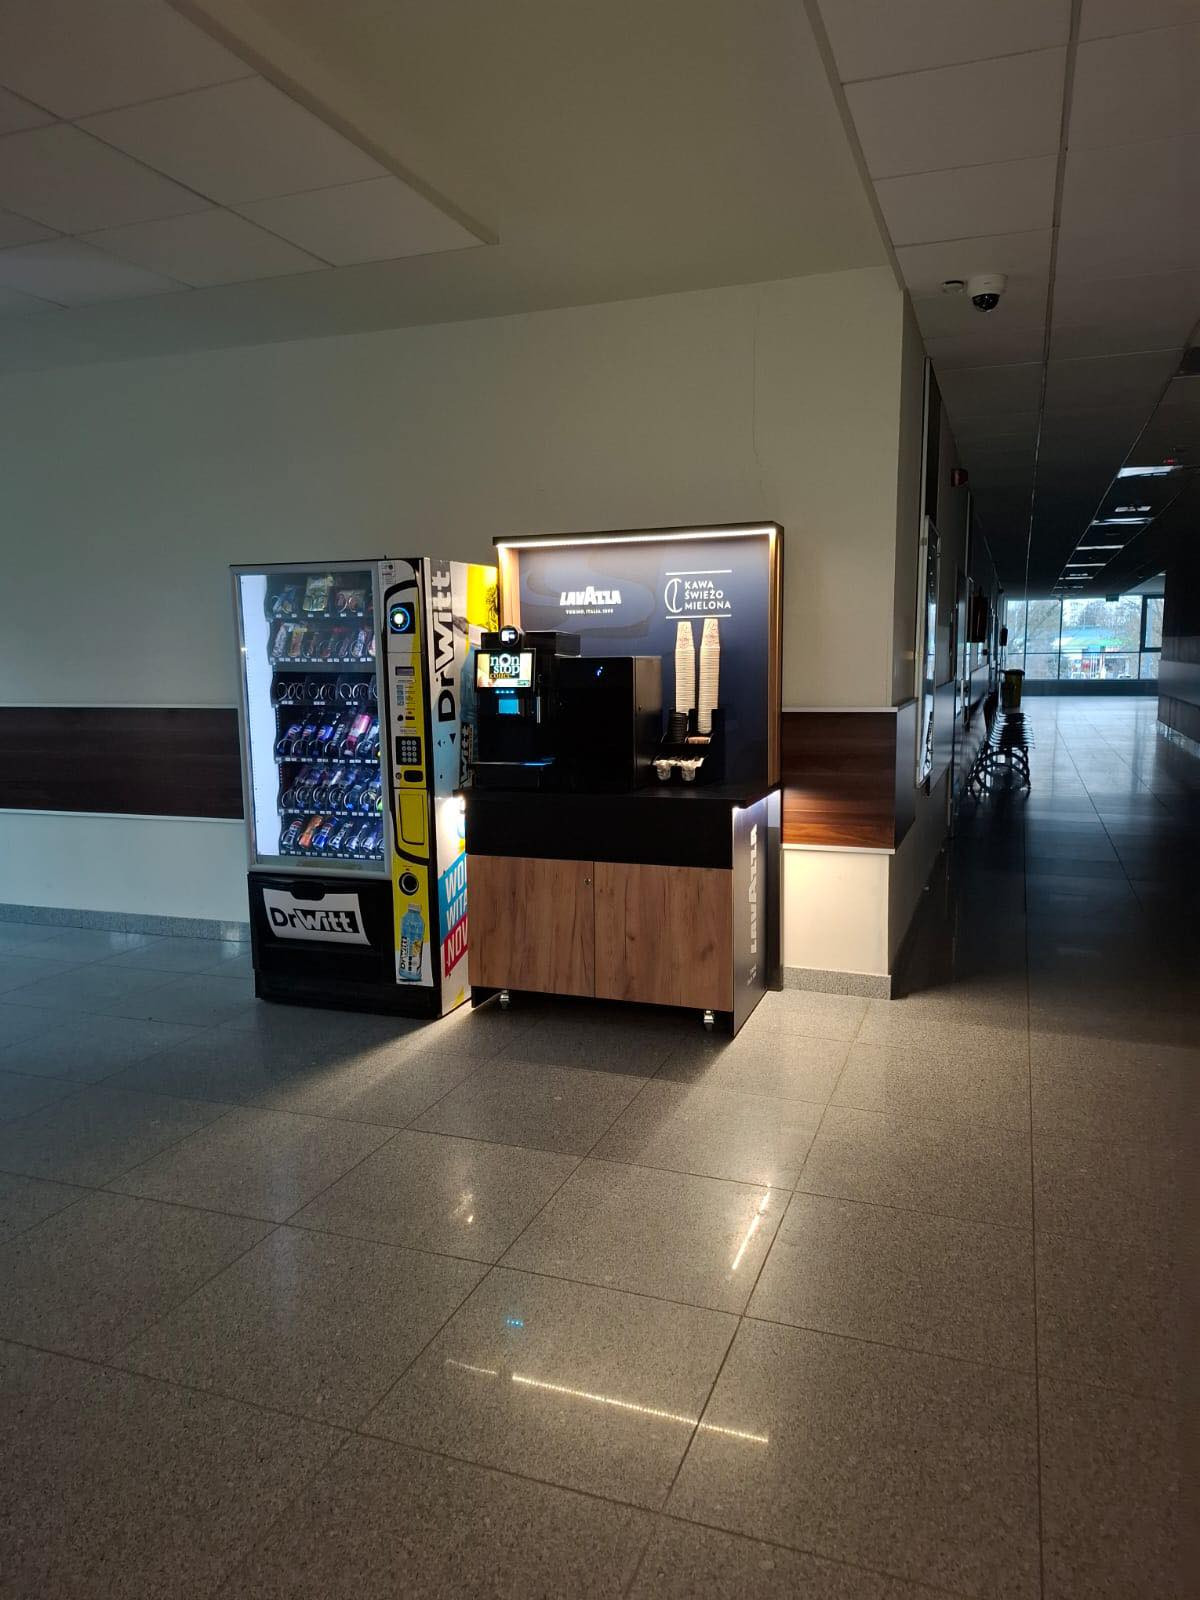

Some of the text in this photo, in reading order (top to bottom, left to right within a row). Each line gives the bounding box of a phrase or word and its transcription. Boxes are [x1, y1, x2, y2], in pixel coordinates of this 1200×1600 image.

[684, 580, 714, 590] KAWA
[684, 589, 724, 600] ŚWIEŻO
[560, 586, 622, 606] LAVAZZA
[684, 600, 731, 610] MIELONA
[431, 571, 456, 722] DrWitt
[493, 664, 520, 676] stop
[445, 855, 467, 904] WO
[748, 824, 758, 953] LAVAZZA
[270, 907, 354, 933] DrWitt
